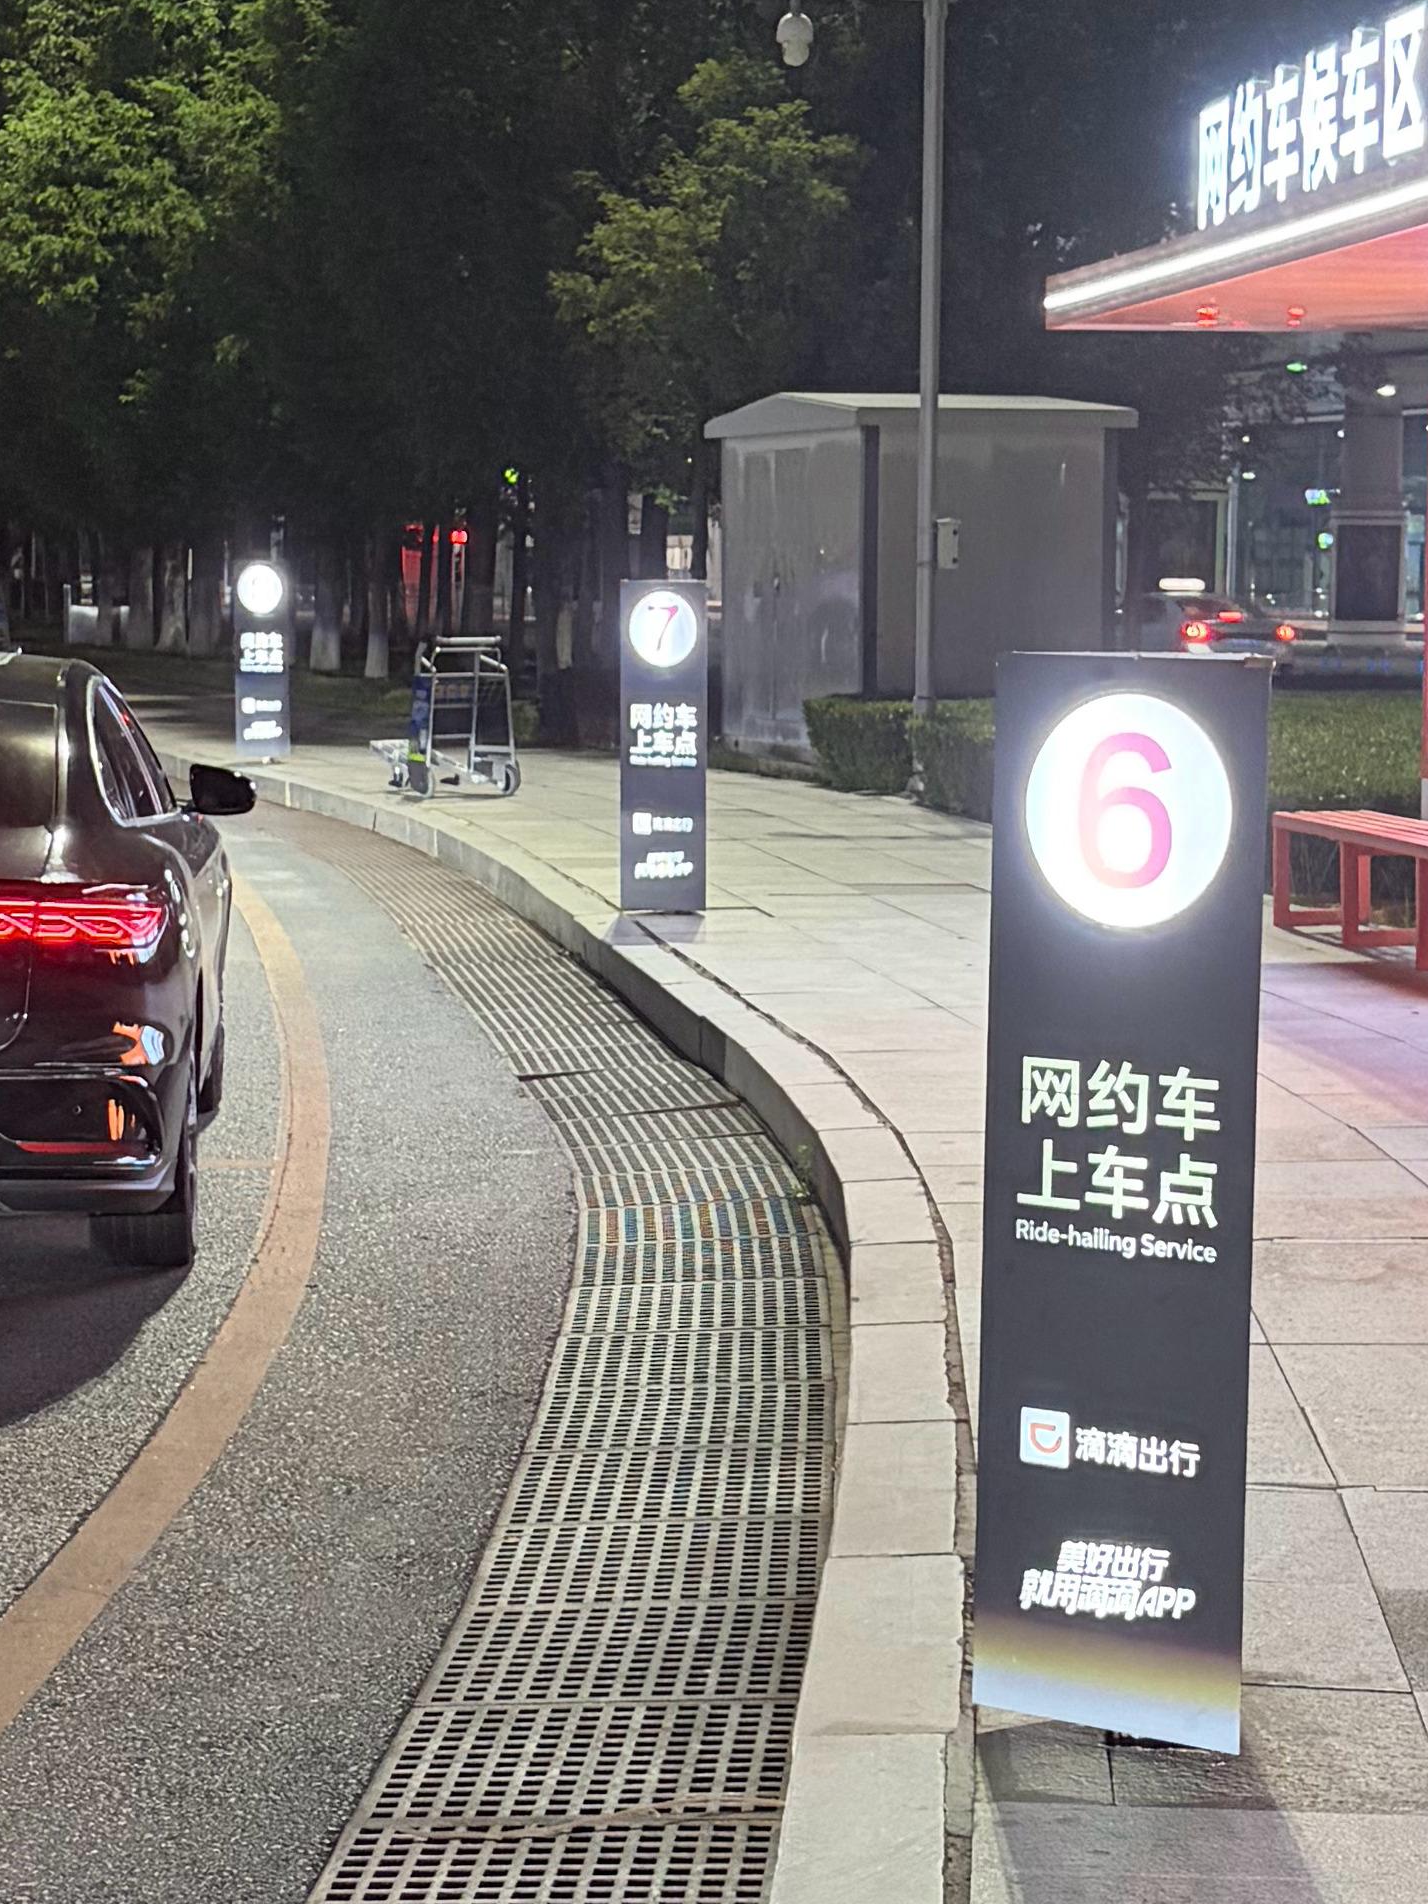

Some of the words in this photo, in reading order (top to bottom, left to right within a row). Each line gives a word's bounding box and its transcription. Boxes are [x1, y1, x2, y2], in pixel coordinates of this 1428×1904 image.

[1197, 2, 1428, 230] 网约车候车区
[647, 604, 679, 652] 7
[1080, 732, 1172, 889] 6
[1021, 1056, 1220, 1142] 网约车
[1016, 1139, 1218, 1227] 上车点
[1015, 1218, 1137, 1259] Ride-hailing
[1140, 1233, 1218, 1264] Service
[1075, 1426, 1201, 1478] 滴滴出行
[1056, 1540, 1171, 1583] 美好出行
